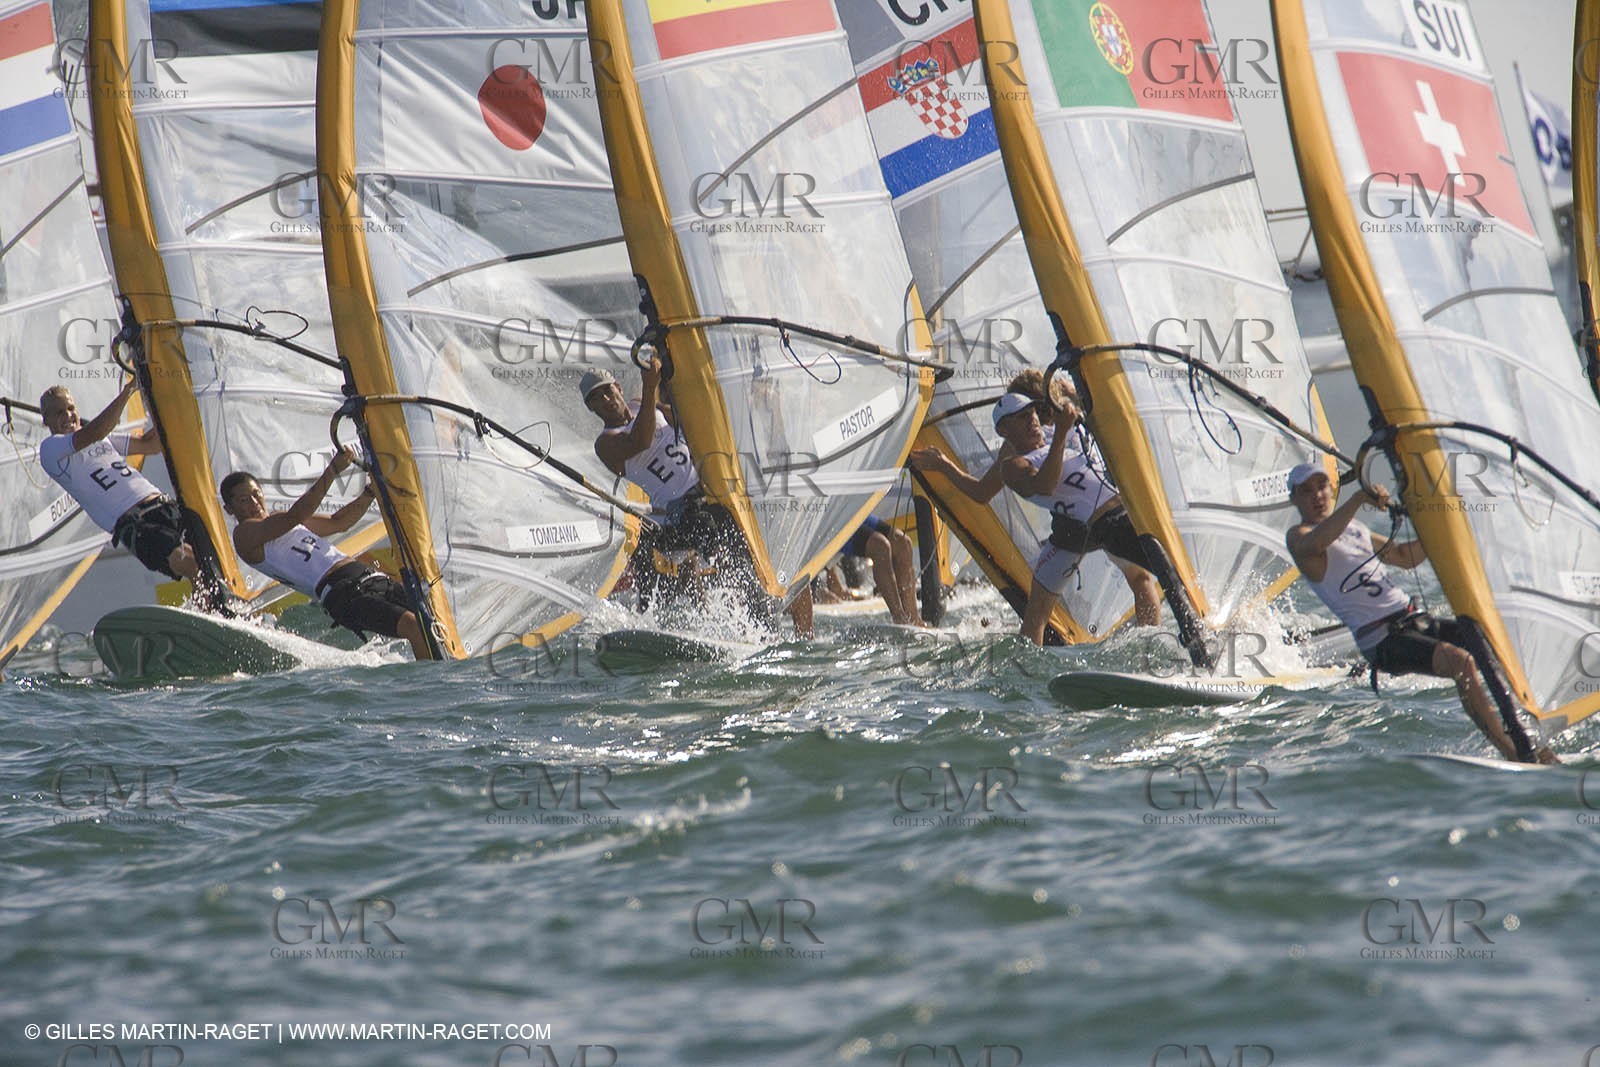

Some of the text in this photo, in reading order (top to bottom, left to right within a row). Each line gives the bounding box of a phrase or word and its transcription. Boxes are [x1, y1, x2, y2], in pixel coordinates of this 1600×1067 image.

[1413, 0, 1472, 61] SUI
[839, 405, 875, 440] PASTOR
[90, 461, 132, 491] ES
[647, 444, 688, 484] ES
[291, 535, 320, 562] JP
[529, 525, 581, 546] TOMIZAWA
